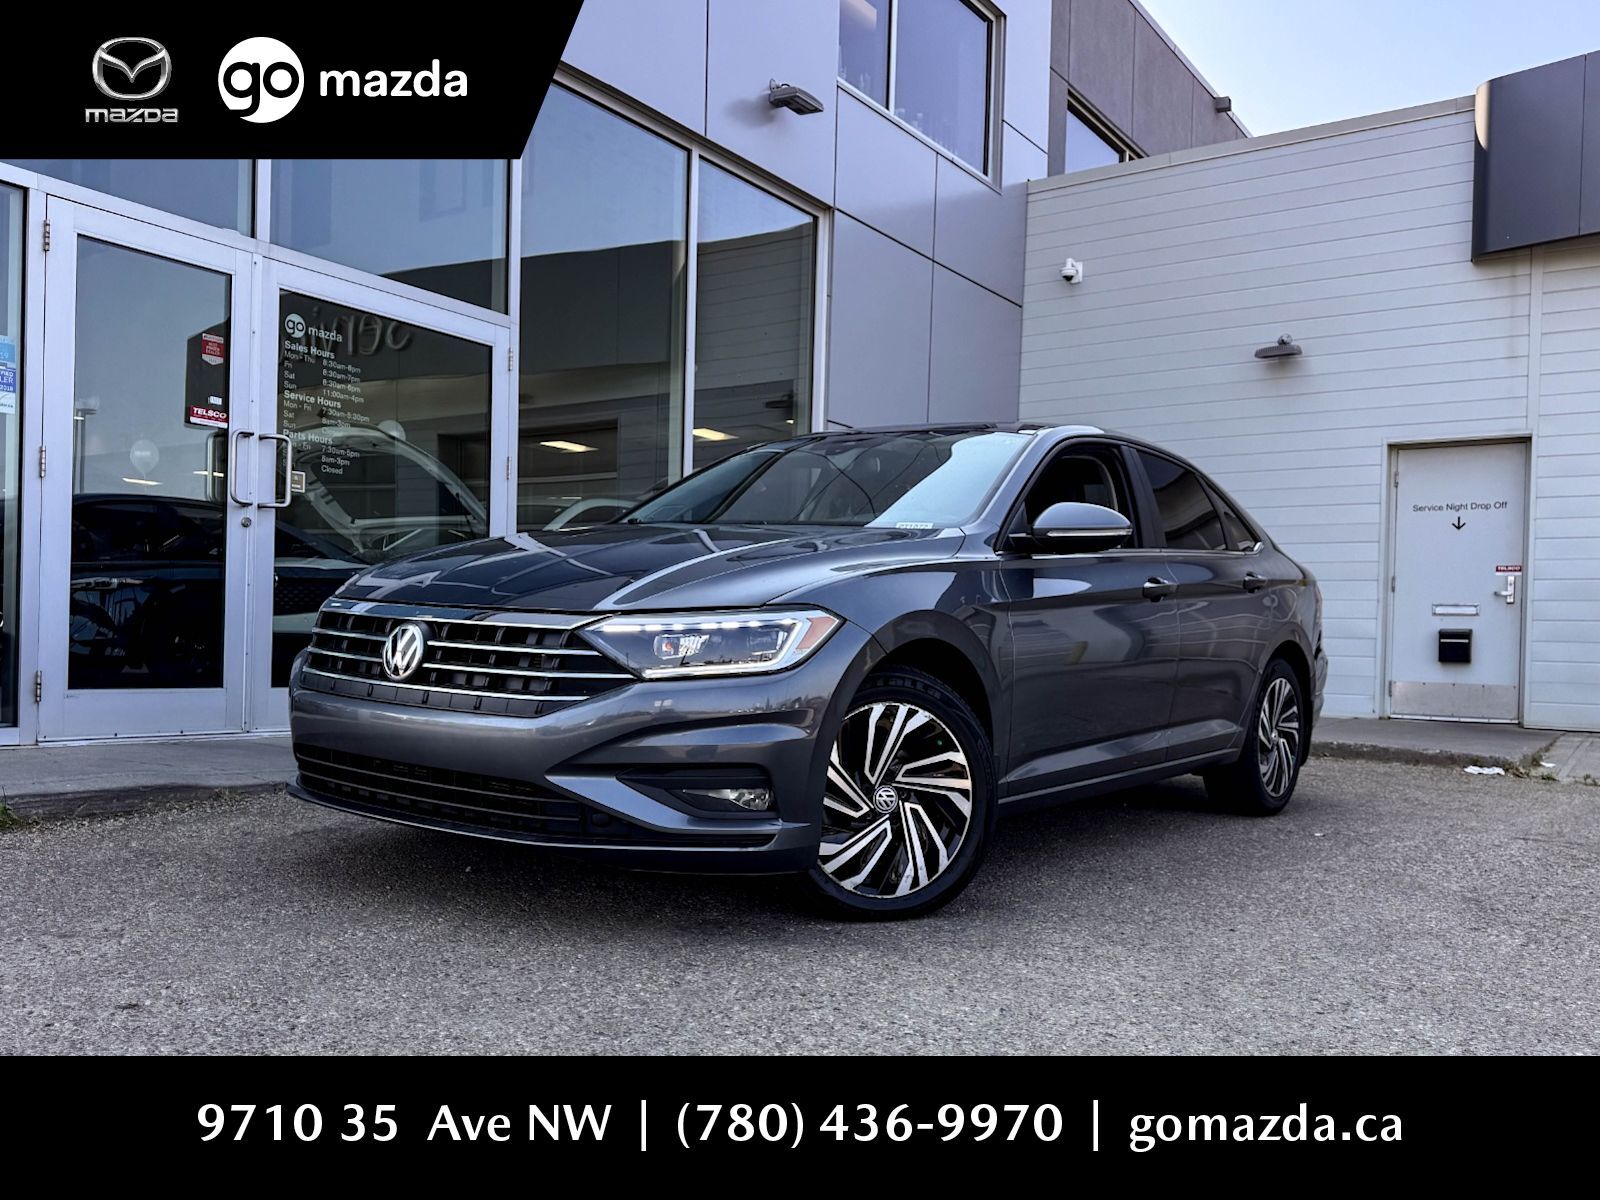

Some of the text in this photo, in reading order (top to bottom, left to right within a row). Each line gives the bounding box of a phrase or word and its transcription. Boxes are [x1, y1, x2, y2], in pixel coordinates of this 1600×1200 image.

[308, 327, 343, 342] mazda
[284, 340, 336, 359] Sales Hours
[284, 350, 299, 360] Mon
[304, 354, 316, 364] Thu
[284, 370, 296, 380] Sat
[284, 380, 297, 390] Sun
[283, 390, 342, 409] Service Hours
[283, 400, 298, 410] Mon
[303, 403, 312, 412] Fri
[193, 406, 227, 419] TELSCO
[283, 410, 295, 418] Sat
[283, 429, 306, 440] Parts
[308, 432, 333, 445] Hours
[321, 465, 343, 475] Closed
[1412, 501, 1508, 512] Service Night Drop Off
